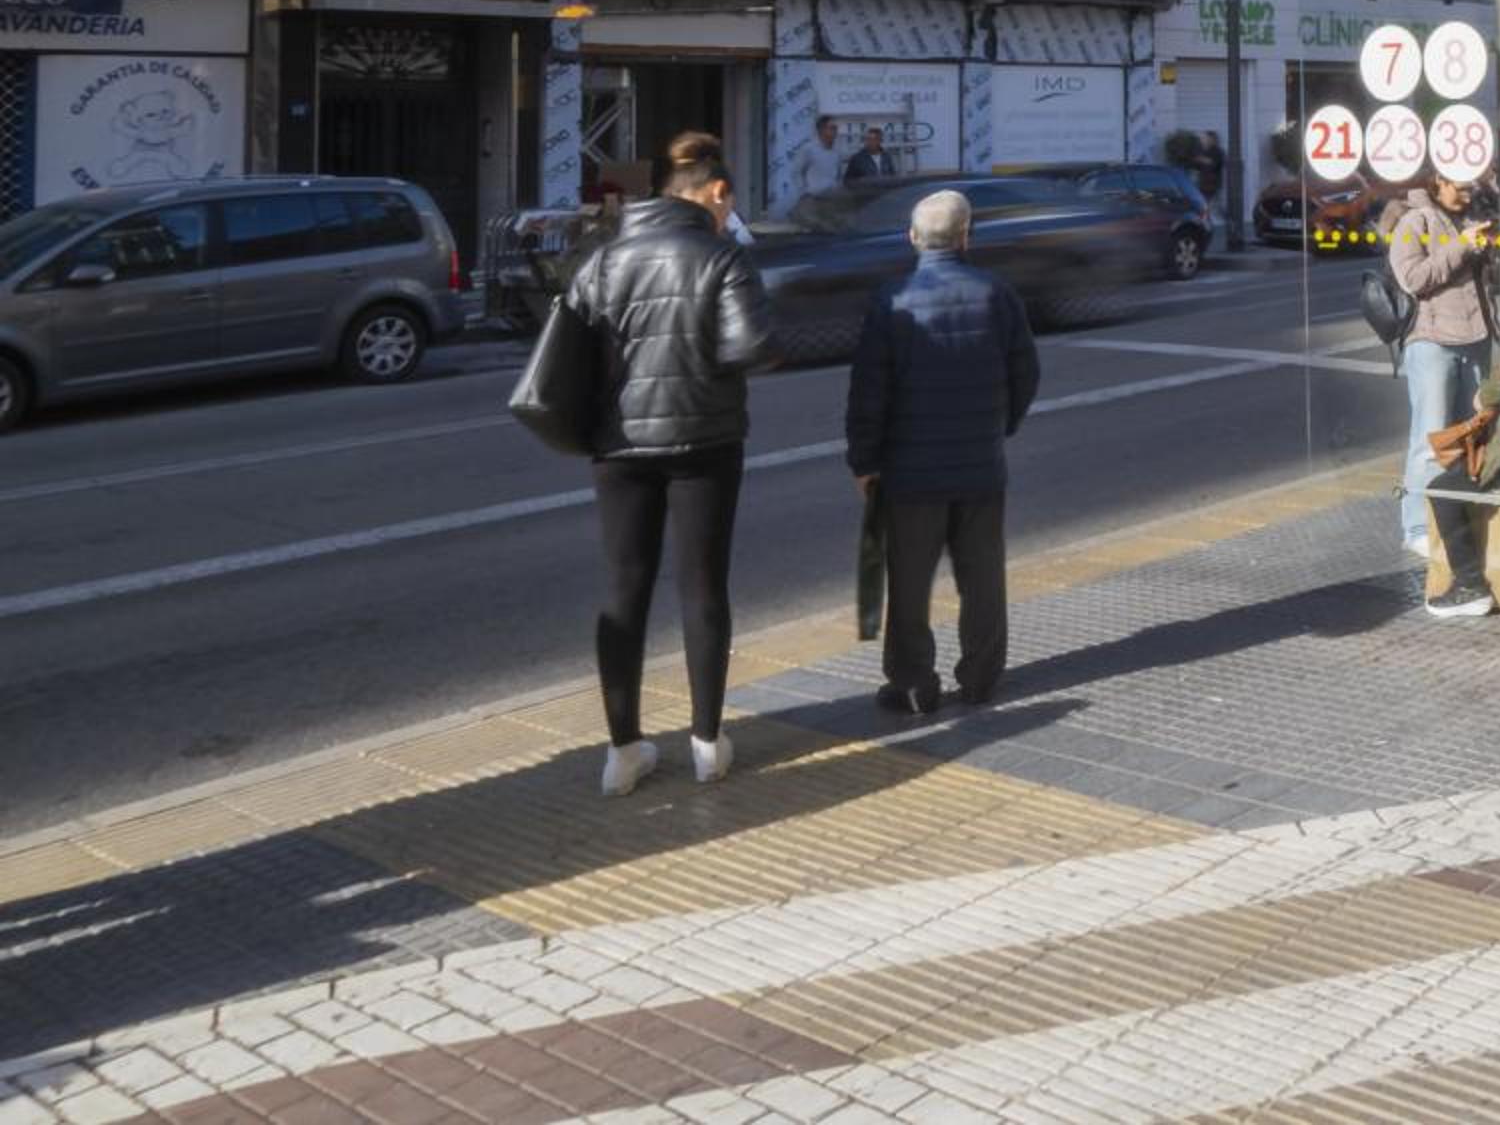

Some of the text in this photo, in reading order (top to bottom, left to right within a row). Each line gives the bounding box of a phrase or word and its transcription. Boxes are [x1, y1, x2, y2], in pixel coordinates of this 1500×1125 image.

[149, 60, 170, 75] DE
[1381, 39, 1468, 86] 7 8
[1034, 74, 1087, 92] IMD
[1310, 117, 1488, 167] 21 23 38
